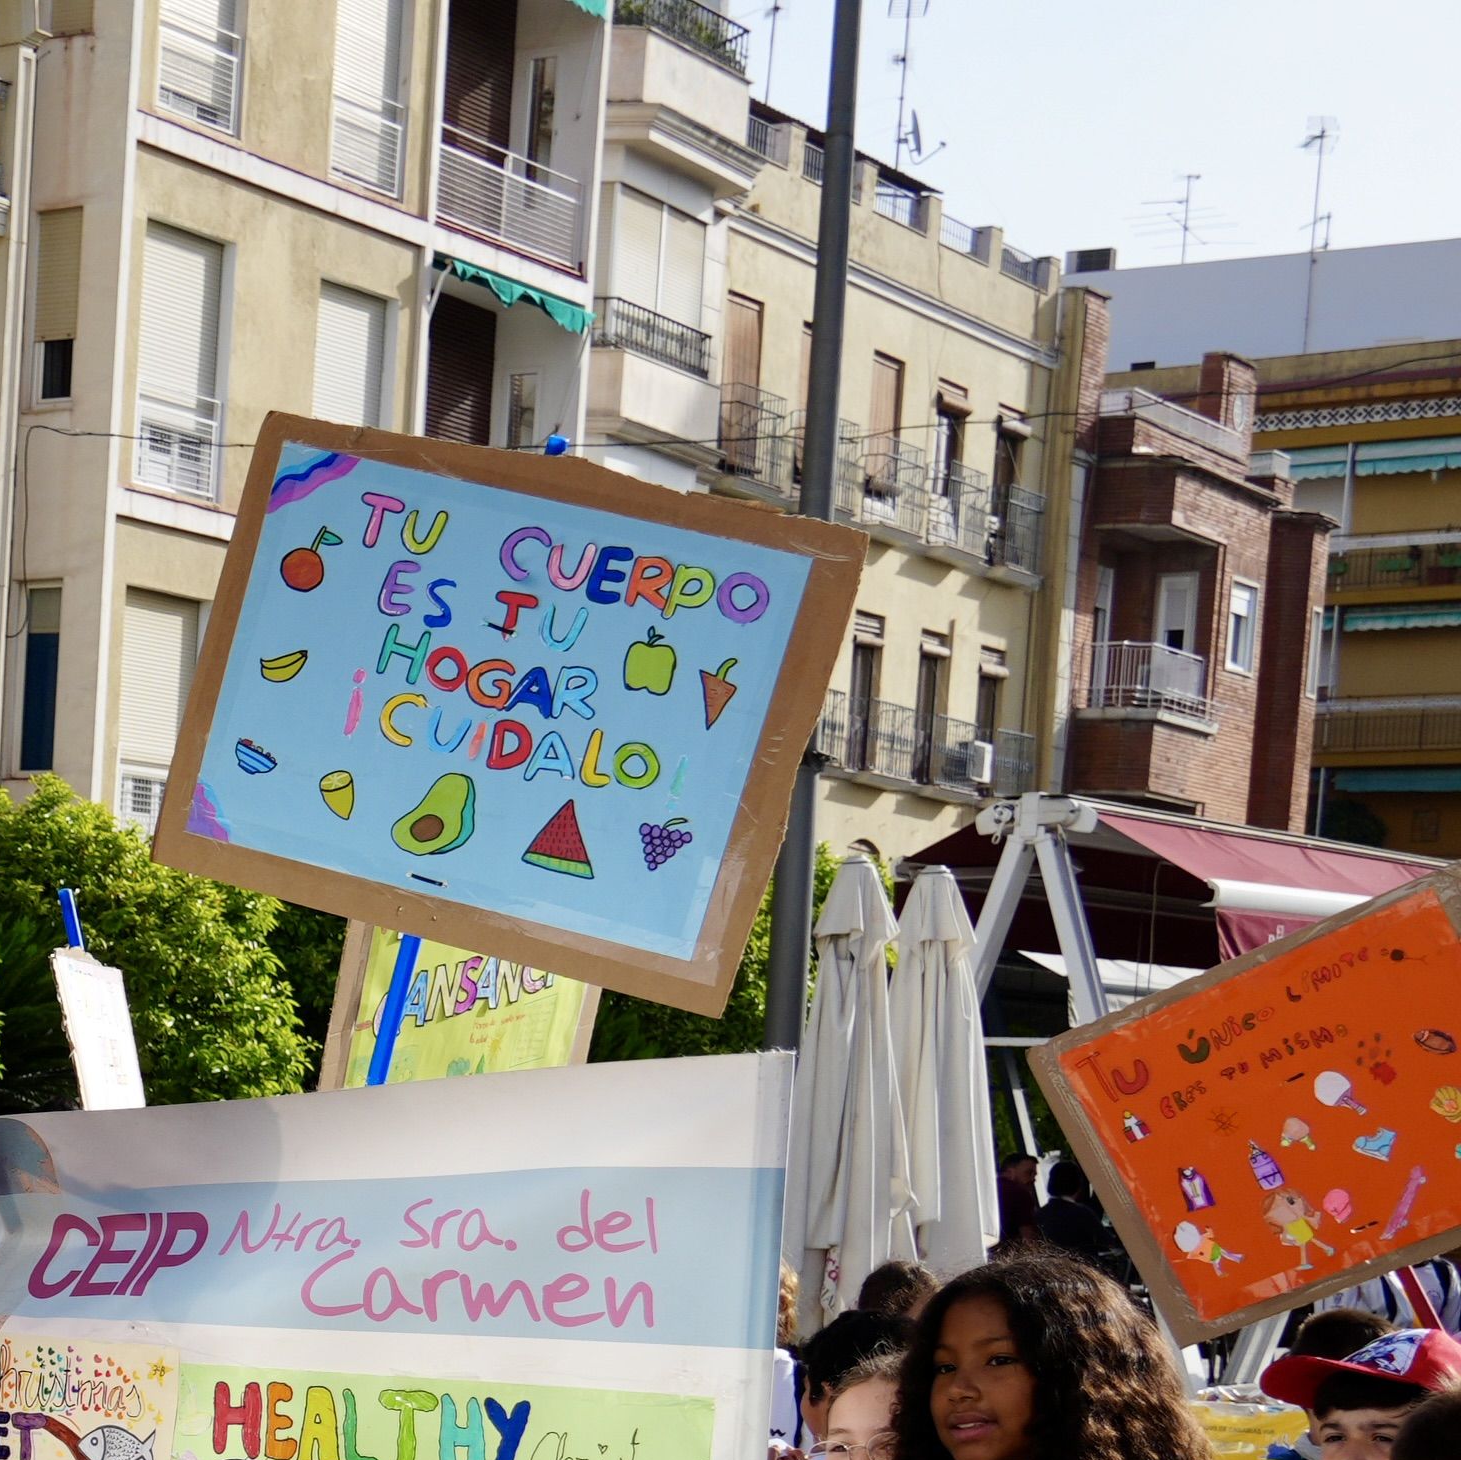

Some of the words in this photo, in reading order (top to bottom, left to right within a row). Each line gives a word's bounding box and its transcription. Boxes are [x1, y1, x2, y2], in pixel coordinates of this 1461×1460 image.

[360, 491, 450, 555] TU
[499, 526, 770, 625] CUERPO
[379, 560, 457, 628] ES
[494, 590, 589, 653] TU
[376, 623, 599, 720] HOGAR
[27, 1212, 209, 1300] CEIP
[218, 1203, 361, 1256] Ntra.
[398, 1197, 517, 1252] Sra.
[556, 1188, 659, 1255] del
[300, 1249, 655, 1329] Carmen
